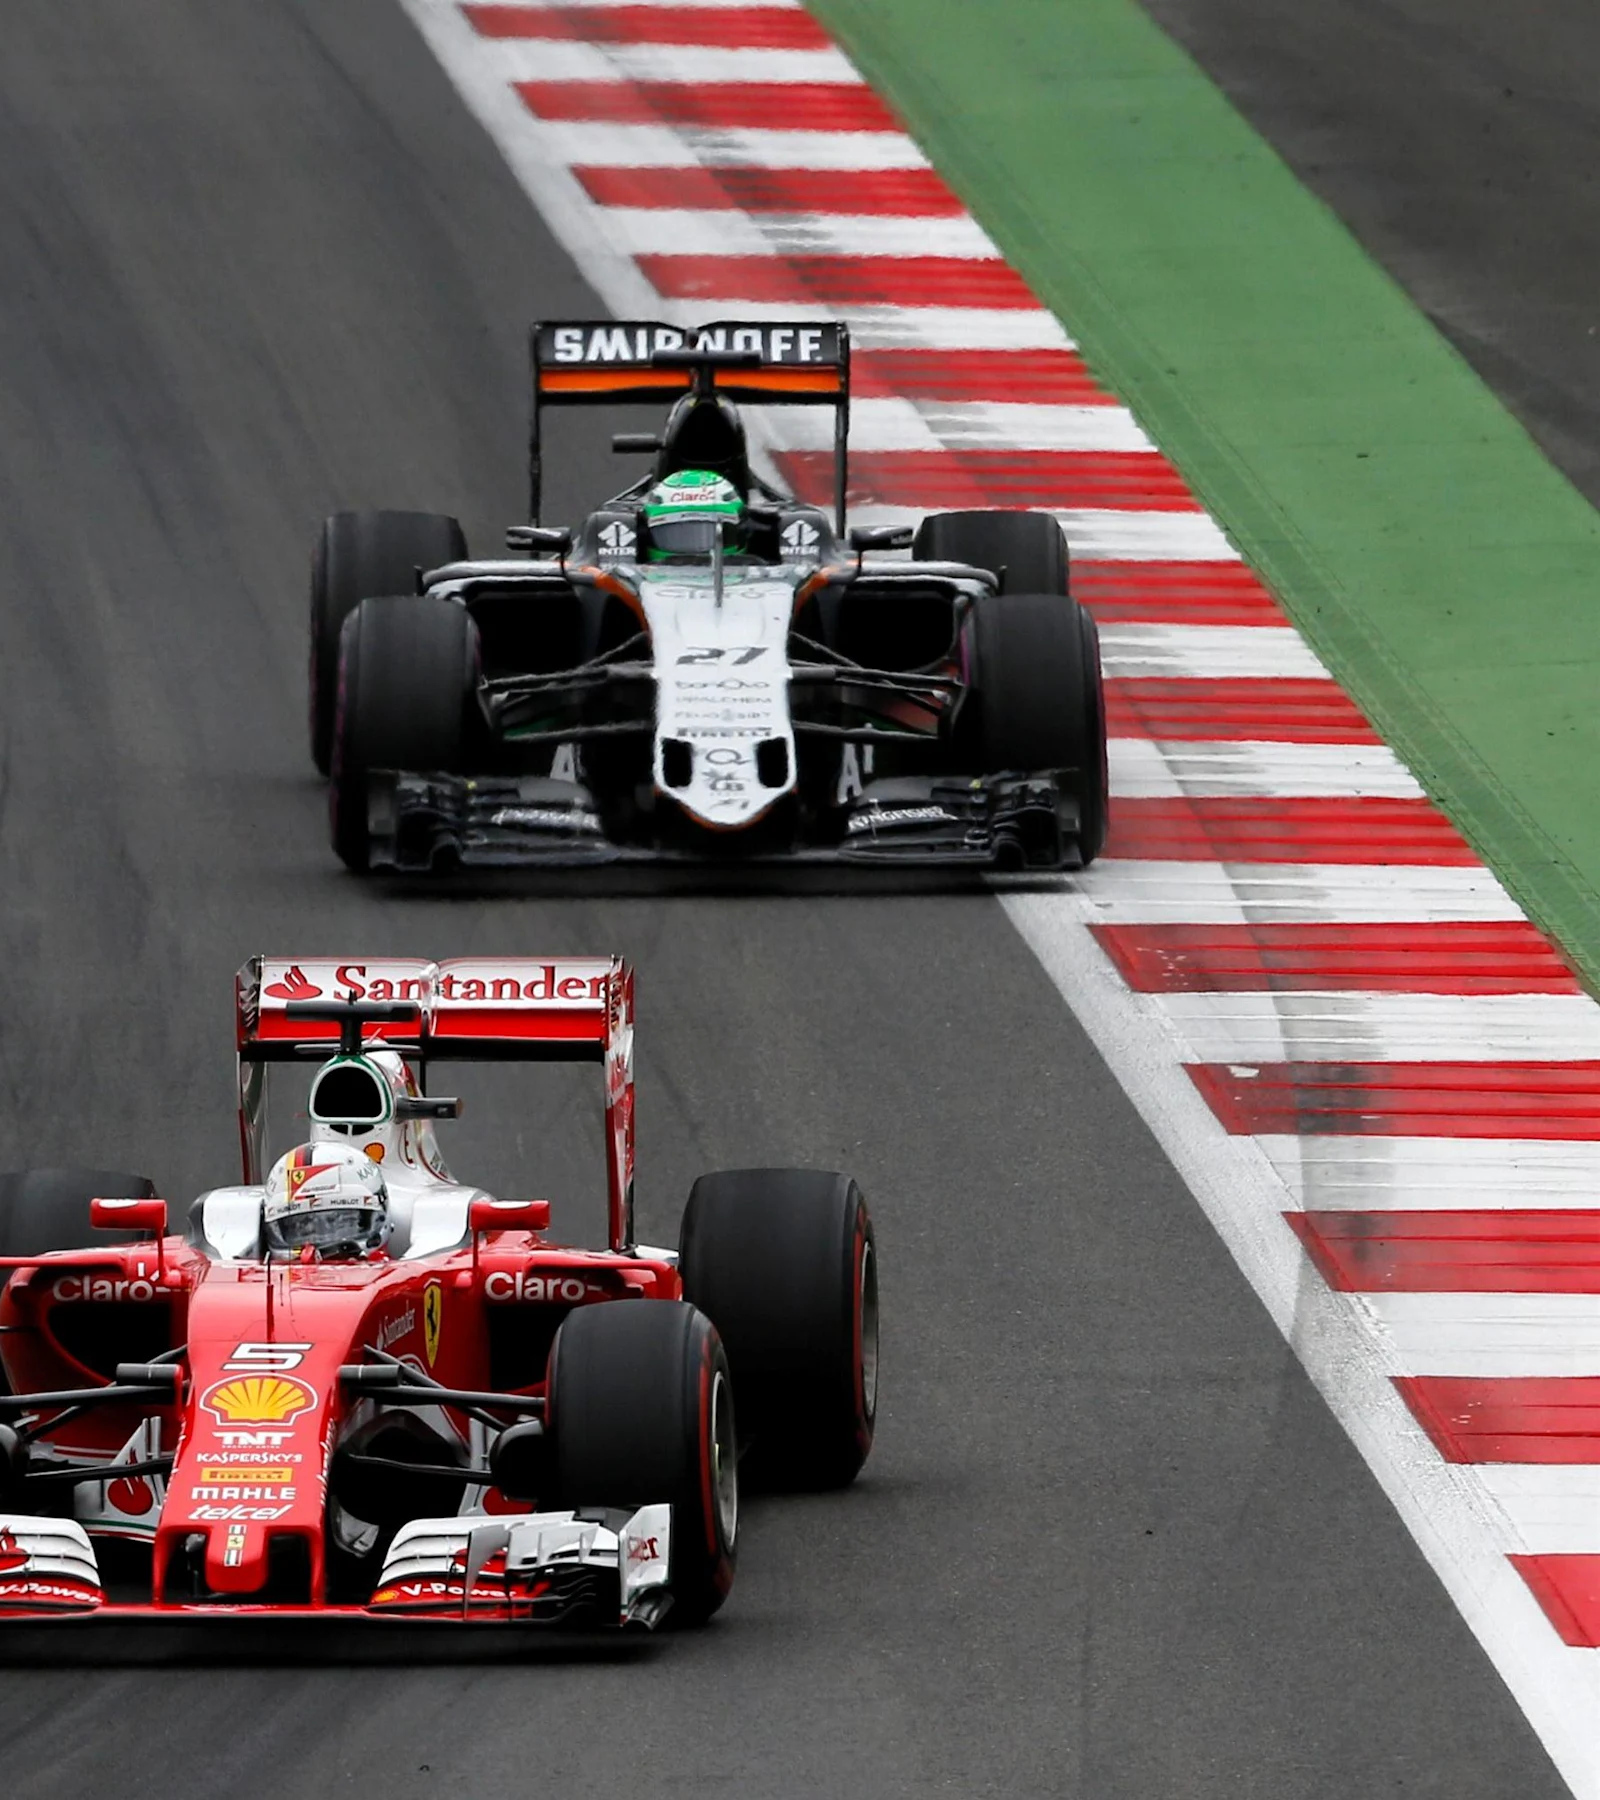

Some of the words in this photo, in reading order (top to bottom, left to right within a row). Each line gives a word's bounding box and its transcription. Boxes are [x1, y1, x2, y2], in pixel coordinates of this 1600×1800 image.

[554, 328, 823, 362] SMIRNOFF
[599, 547, 636, 555] INTER
[675, 646, 769, 666] 27
[333, 965, 607, 1001] Santander
[330, 1198, 360, 1206] HUBLOT
[52, 1274, 154, 1302] Claro
[484, 1271, 586, 1301] Claro
[222, 1343, 314, 1370] 5
[212, 1431, 296, 1446] TNT
[191, 1486, 297, 1500] MAHLE
[187, 1503, 294, 1520] telcel
